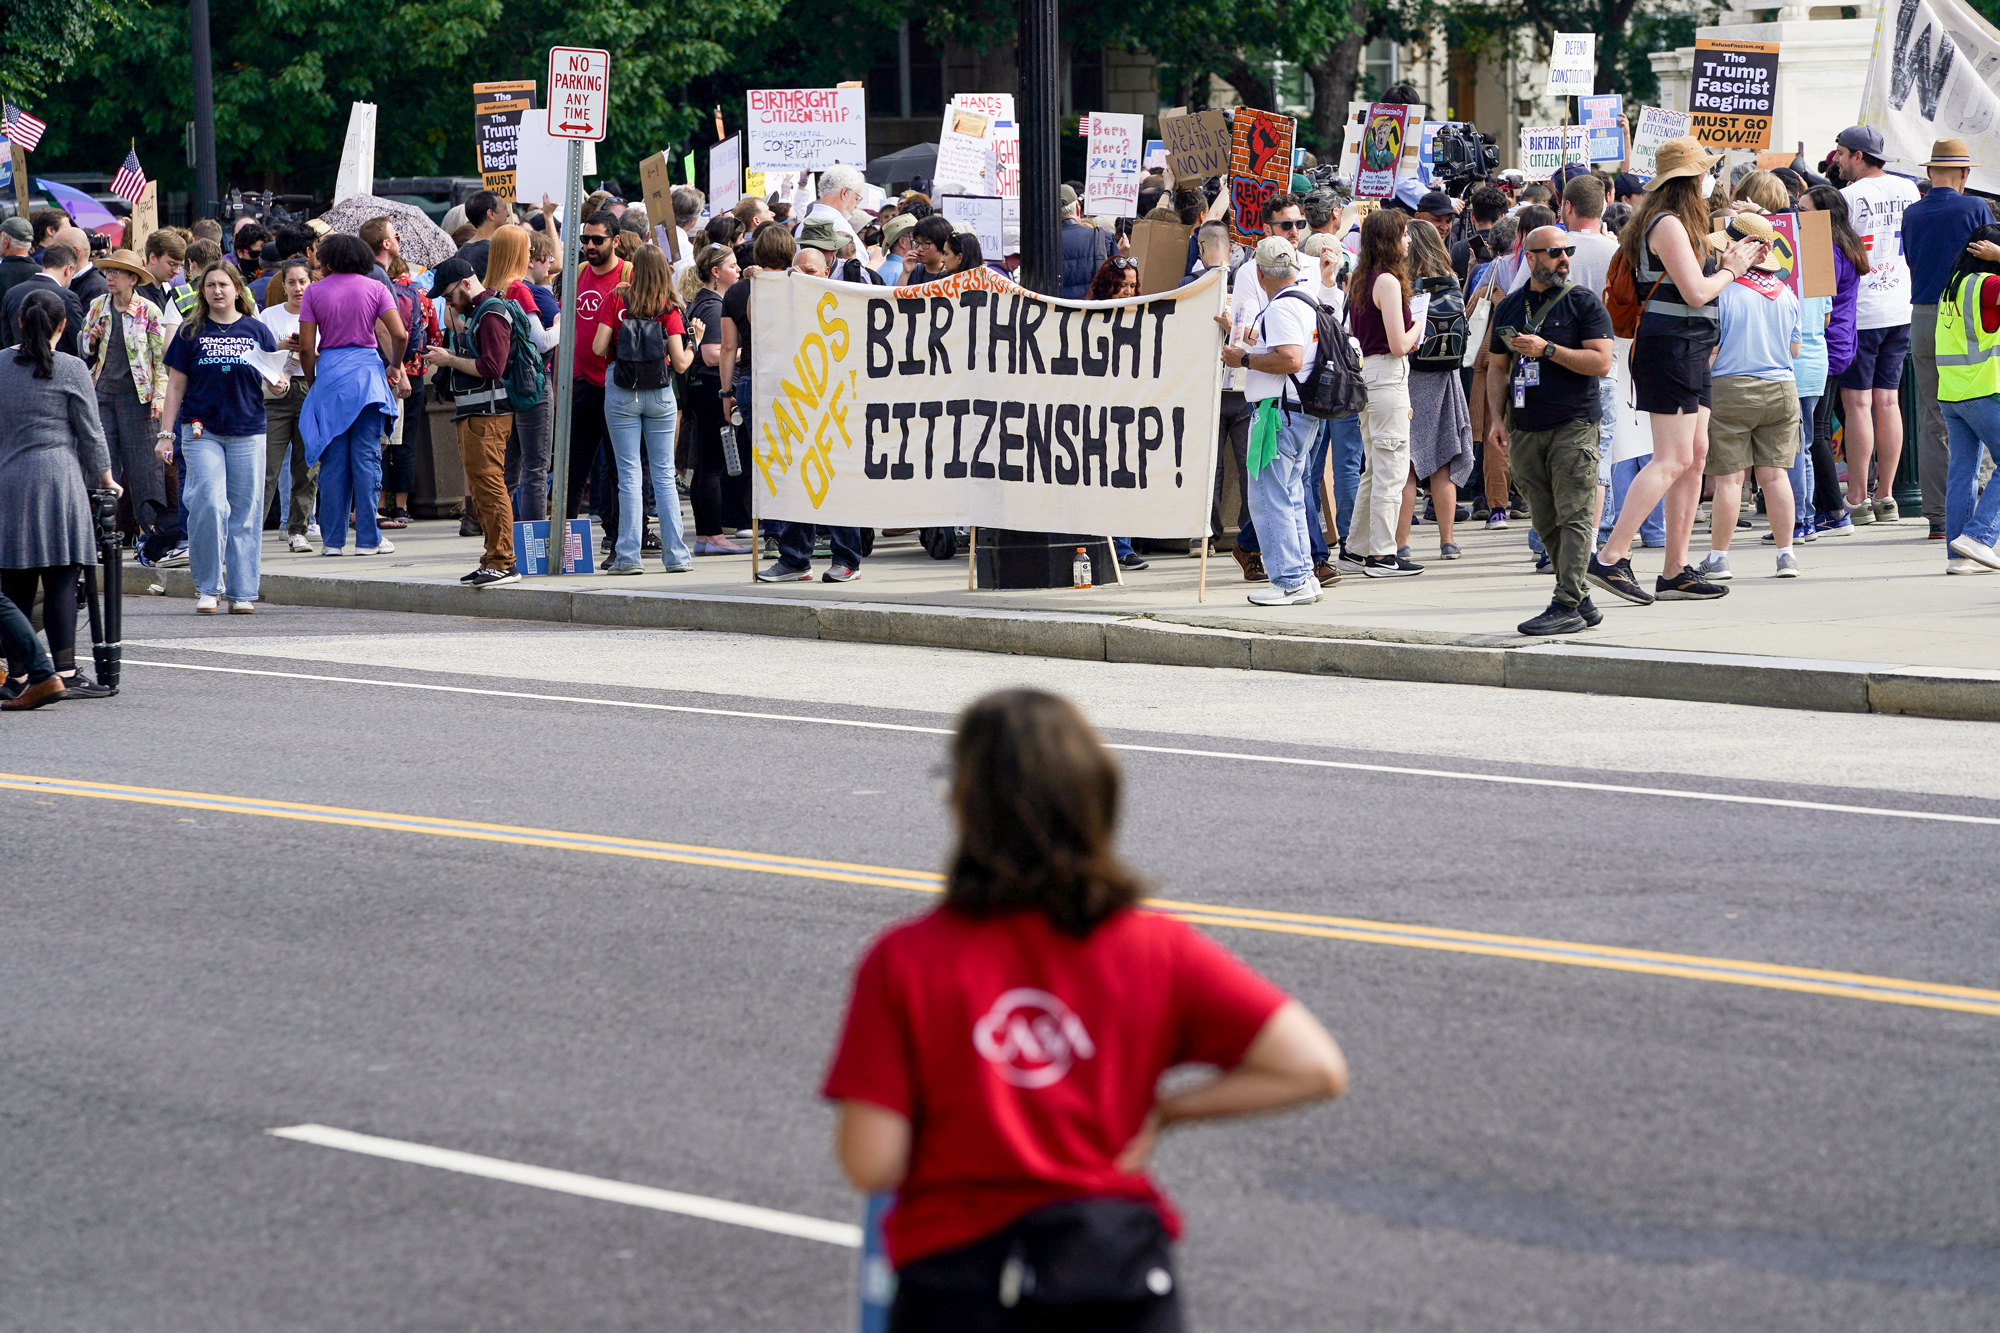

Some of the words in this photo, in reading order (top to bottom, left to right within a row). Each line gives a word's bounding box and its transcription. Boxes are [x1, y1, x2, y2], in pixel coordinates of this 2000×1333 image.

[1565, 40, 1587, 55] DEFEND
[569, 56, 590, 72] NO
[1722, 53, 1746, 64] The
[1552, 69, 1592, 84] CONSTITUTION
[1703, 62, 1768, 82] Trump
[555, 73, 602, 92] PARKING
[1698, 78, 1770, 95] Fascist
[494, 93, 512, 101] The
[566, 93, 590, 106] ANY
[751, 90, 838, 110] BIRTHRIGHT
[961, 97, 1002, 108] HANDS
[1585, 100, 1616, 108] AMERICAN
[1695, 92, 1769, 112] Regime
[491, 114, 506, 124] The
[564, 106, 590, 120] TIME
[761, 107, 850, 124] CITIZENSHIP
[1593, 110, 1608, 118] BORN
[1646, 112, 1686, 128] BIRTHRIGHT
[1094, 117, 1126, 136] Born
[1166, 114, 1207, 140] NEVER
[1588, 120, 1615, 128] CHILDREN
[1642, 123, 1684, 138] CITIZENSHIP
[1692, 116, 1740, 128] MUST
[1744, 118, 1768, 130] GO
[751, 130, 825, 140] FUNDAMENTAL
[1596, 129, 1608, 138] ARE
[1697, 128, 1762, 144] NOW!!!
[764, 137, 856, 152] CONSTITUTIONAL
[1172, 133, 1212, 156] AGAIN
[1214, 129, 1227, 148] IS
[1530, 136, 1582, 150] BIRTHRIGHT
[784, 149, 821, 160] RIGHT
[1176, 147, 1230, 176] NOW!
[486, 174, 514, 186] MUST
[1089, 182, 1138, 196] CITIZEN
[955, 202, 982, 216] UPHOLD
[1884, 214, 1902, 226] Wors
[867, 290, 1176, 378] BIRTHRIGHT
[752, 292, 850, 498] HANDS
[800, 370, 858, 509] OFF!
[864, 399, 1185, 489] CITIZENSHIP!
